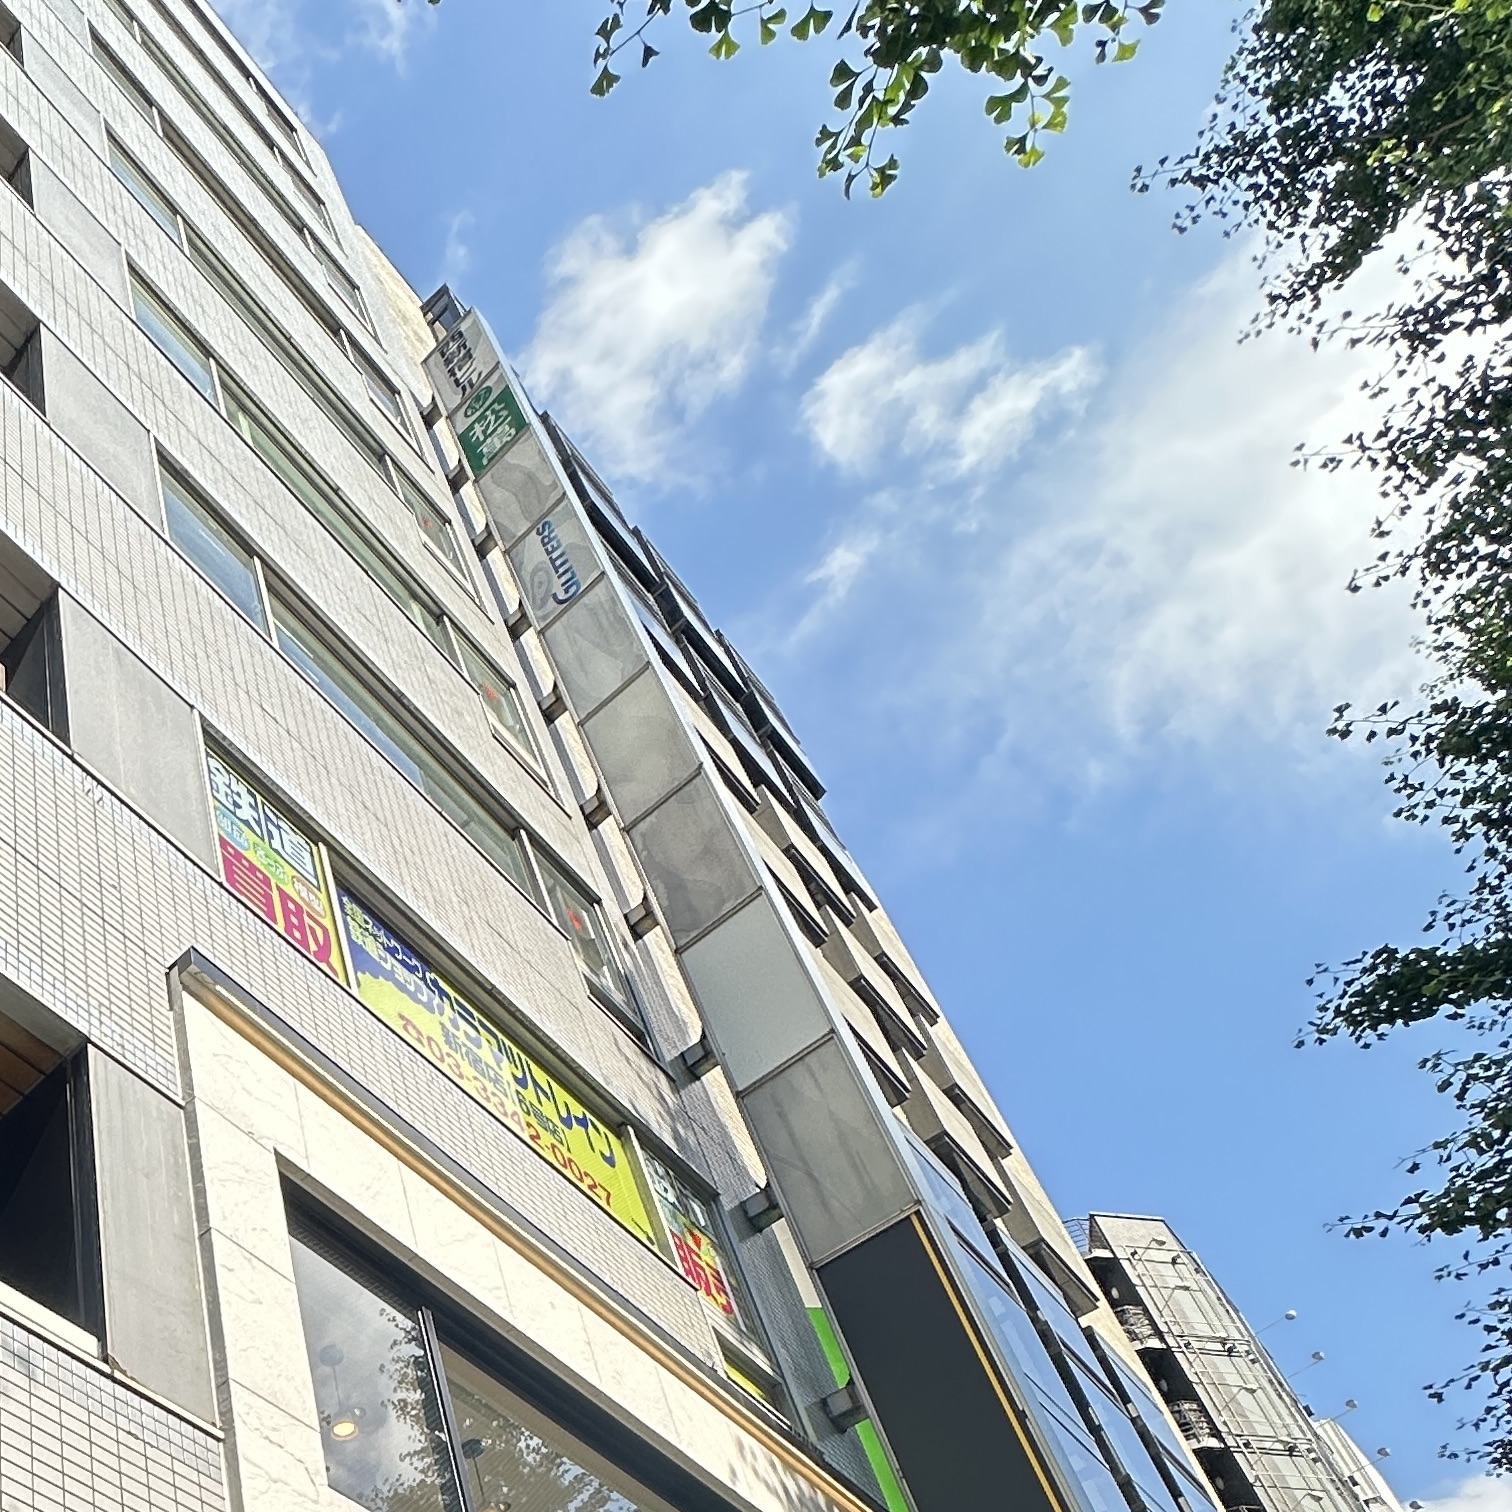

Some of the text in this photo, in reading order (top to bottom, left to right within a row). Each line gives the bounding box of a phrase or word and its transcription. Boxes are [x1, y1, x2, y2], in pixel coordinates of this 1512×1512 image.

[536, 520, 582, 606] GLITTERS
[208, 756, 321, 890] 鉄道
[219, 834, 338, 978] 買取
